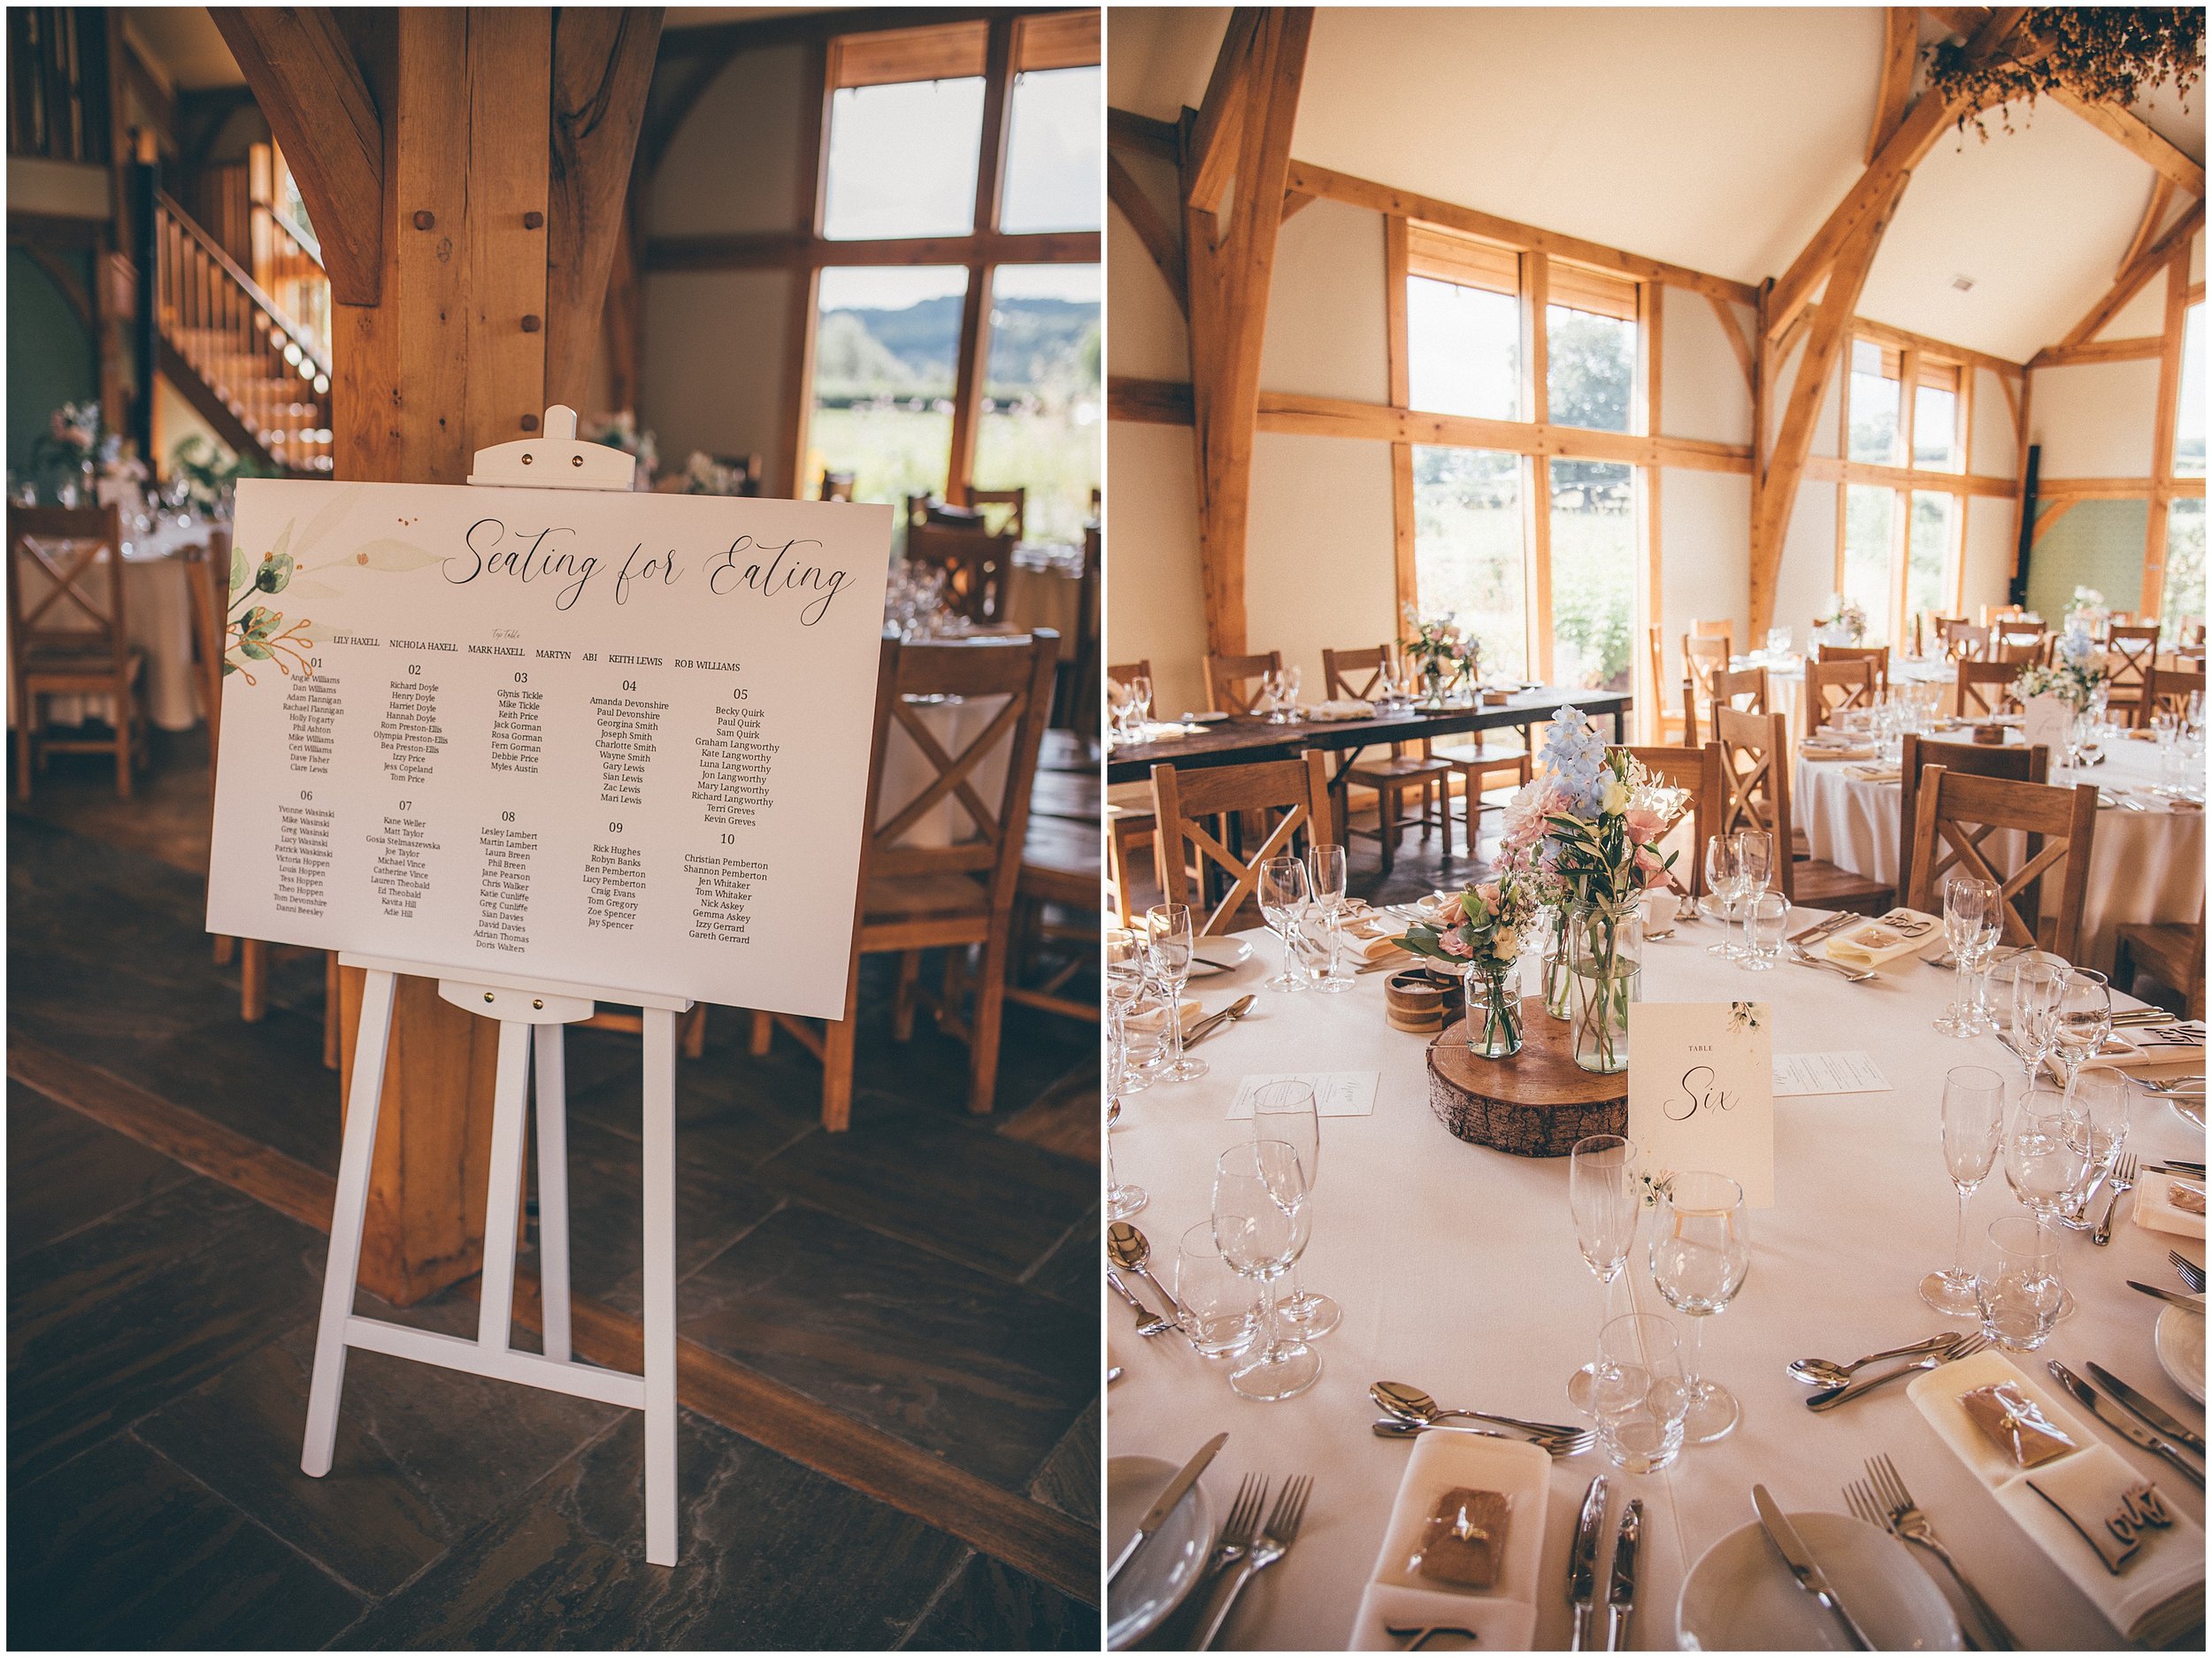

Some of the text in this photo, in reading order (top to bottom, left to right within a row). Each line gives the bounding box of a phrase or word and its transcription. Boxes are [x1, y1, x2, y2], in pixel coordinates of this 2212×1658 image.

[442, 518, 856, 626] Seating for Eating
[334, 636, 741, 672] LILY HAXELL NICHOLA HAXELL MARK HAXELL MARTYN ABI KEITH LEWIS ROB WILLIAMS
[311, 658, 322, 668] 01
[409, 664, 420, 675] 02
[515, 672, 527, 683] 03
[390, 681, 439, 693] Richard Doyle
[623, 680, 636, 691] 04
[497, 689, 542, 700] Glynis Tickle
[733, 688, 748, 700] 05
[389, 702, 436, 713] Harriet Doyle
[590, 697, 669, 710] Amanda Devonshire
[387, 711, 436, 724] Hannah Doyle
[616, 710, 660, 719] Devonshire
[716, 707, 764, 718] Becky Quirk
[511, 722, 541, 731] Gorman
[597, 718, 633, 729] Georgina
[738, 719, 760, 728] Quirk
[373, 731, 448, 744] Olympia Preston-Ellis
[511, 733, 542, 741] Gorman
[601, 730, 652, 741] Joseph Smith
[737, 730, 759, 739] Quirk
[511, 743, 541, 752] Gorman
[595, 740, 656, 752] Charlotte Smith
[695, 738, 780, 753] Graham Langworthy
[492, 752, 518, 761] Debbie
[600, 751, 626, 761] Wayne
[722, 751, 771, 764] Langworthy
[399, 764, 433, 773] Copeland
[491, 762, 538, 773] Myles Austin
[603, 762, 644, 772] Gary Lewis
[622, 774, 642, 783] Lewis
[702, 771, 766, 785] Jon Langworthy
[301, 791, 312, 801] 06
[692, 792, 773, 808] Richard Langworthy
[399, 801, 411, 810] 07
[727, 806, 755, 815] Greves
[384, 817, 426, 827] Kane Weller
[502, 811, 515, 822] 08
[728, 817, 756, 826] Greves
[610, 822, 623, 833] 09
[403, 829, 424, 838] Taylor
[481, 827, 537, 840] Lesley Lambert
[721, 833, 734, 844] 10
[480, 837, 537, 850] Martin Lambert
[486, 848, 530, 860] Laura Breen
[594, 844, 641, 856] Rick Hughes
[592, 855, 641, 866] Robyn Banks
[685, 855, 768, 870] Christian Pemberton
[500, 871, 530, 880] Pearson
[603, 867, 645, 878] Pemberton
[684, 865, 767, 880] Shannon Pemberton
[371, 876, 429, 889] Lauren Theobald
[583, 875, 645, 888] Lucy Pemberton
[714, 879, 750, 889] Whitaker
[480, 889, 529, 902] Katie Cunliffe
[591, 887, 635, 898] Craig Evans
[695, 887, 752, 901] Tom Whitaker
[588, 896, 638, 910] Tom Gregory
[701, 899, 744, 912] Nick Askey
[588, 907, 636, 919] Zoe Spencer
[693, 909, 750, 924] Gemma Askey
[473, 930, 529, 943] Adrian Thomas
[689, 930, 749, 944] Gareth Gerrard
[1663, 1066, 1740, 1121] Six
